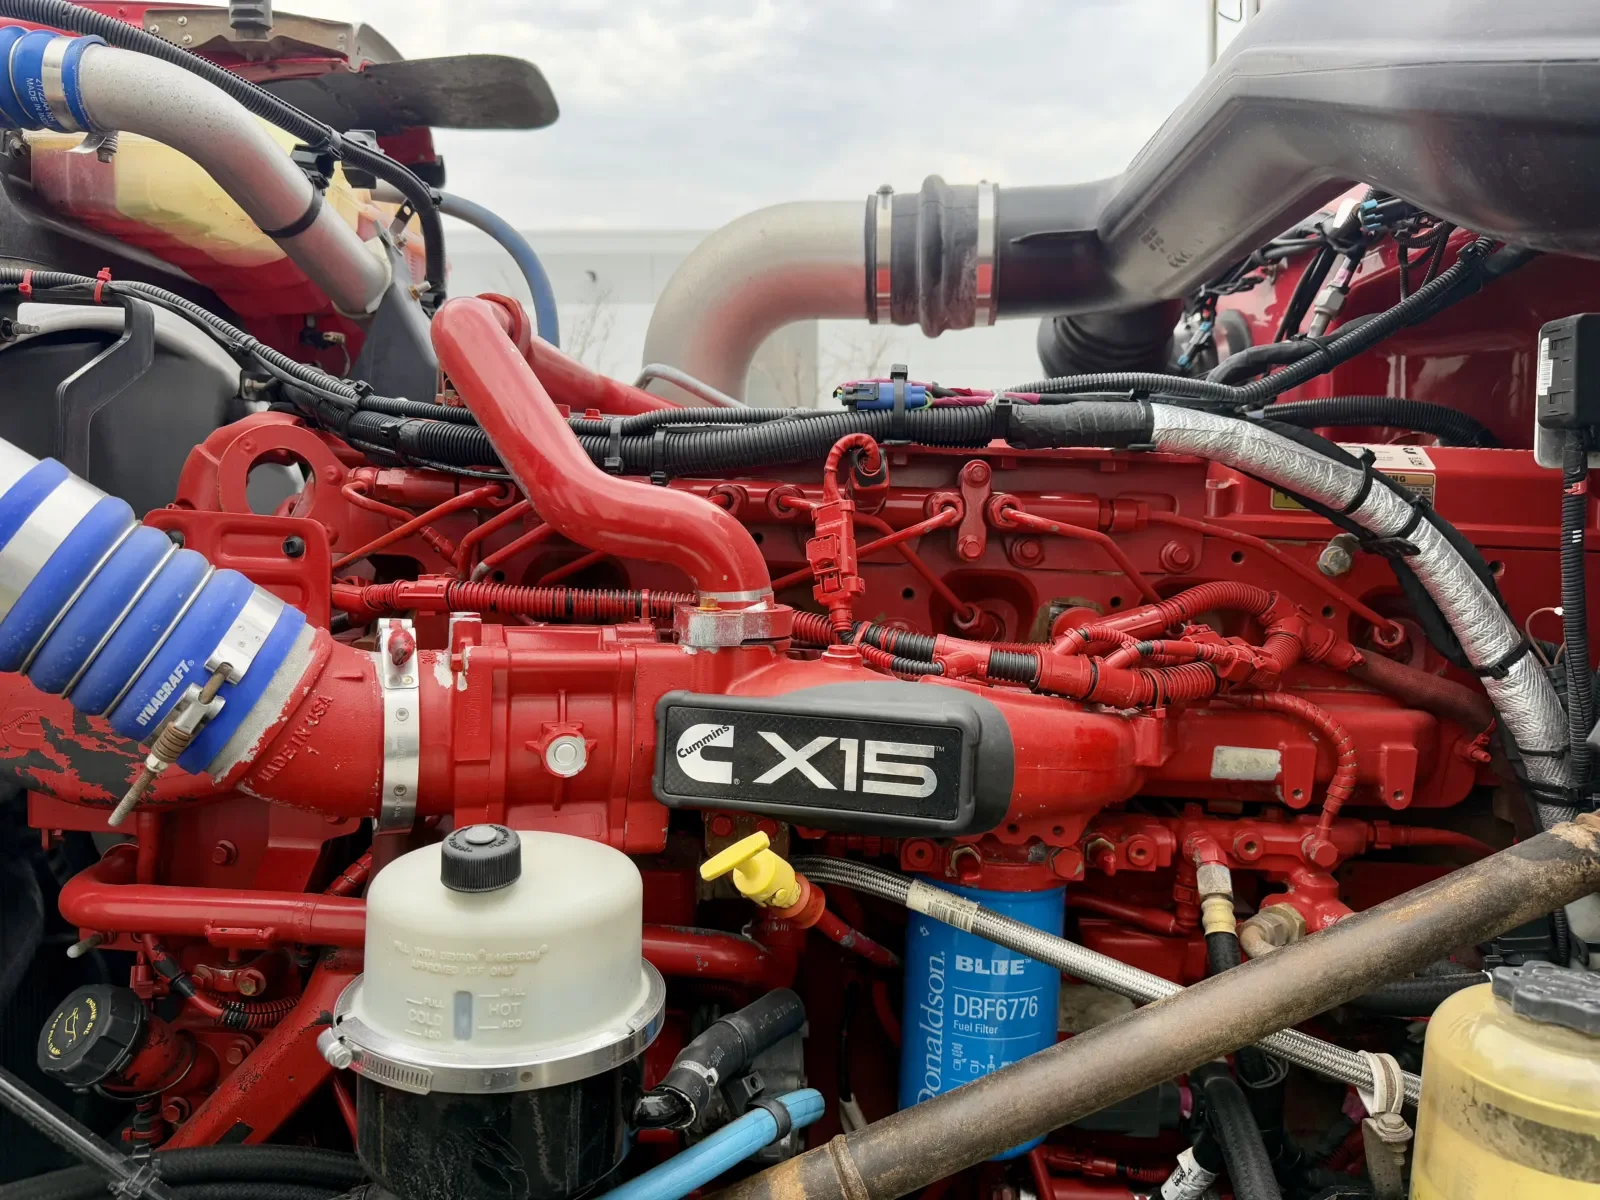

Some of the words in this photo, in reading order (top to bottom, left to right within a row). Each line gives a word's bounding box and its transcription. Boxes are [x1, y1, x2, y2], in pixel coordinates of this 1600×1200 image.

[26, 77, 38, 102] MADE
[34, 103, 43, 111] IN
[303, 694, 334, 727] USA
[677, 725, 730, 759] Cummins
[411, 959, 459, 976] APPROVED
[464, 965, 485, 977] ATF
[489, 964, 519, 977] ONLY
[501, 987, 526, 997] FULL
[424, 996, 445, 1009] FULL
[488, 1002, 522, 1016] HOT
[954, 994, 1038, 1021] DBF6776
[408, 1008, 444, 1026] COLD
[501, 1018, 523, 1028] ADD
[83, 1022, 93, 1036] OIL
[423, 1028, 442, 1040] ADD
[953, 1019, 973, 1033] Fuel
[975, 1023, 999, 1035] Filter
